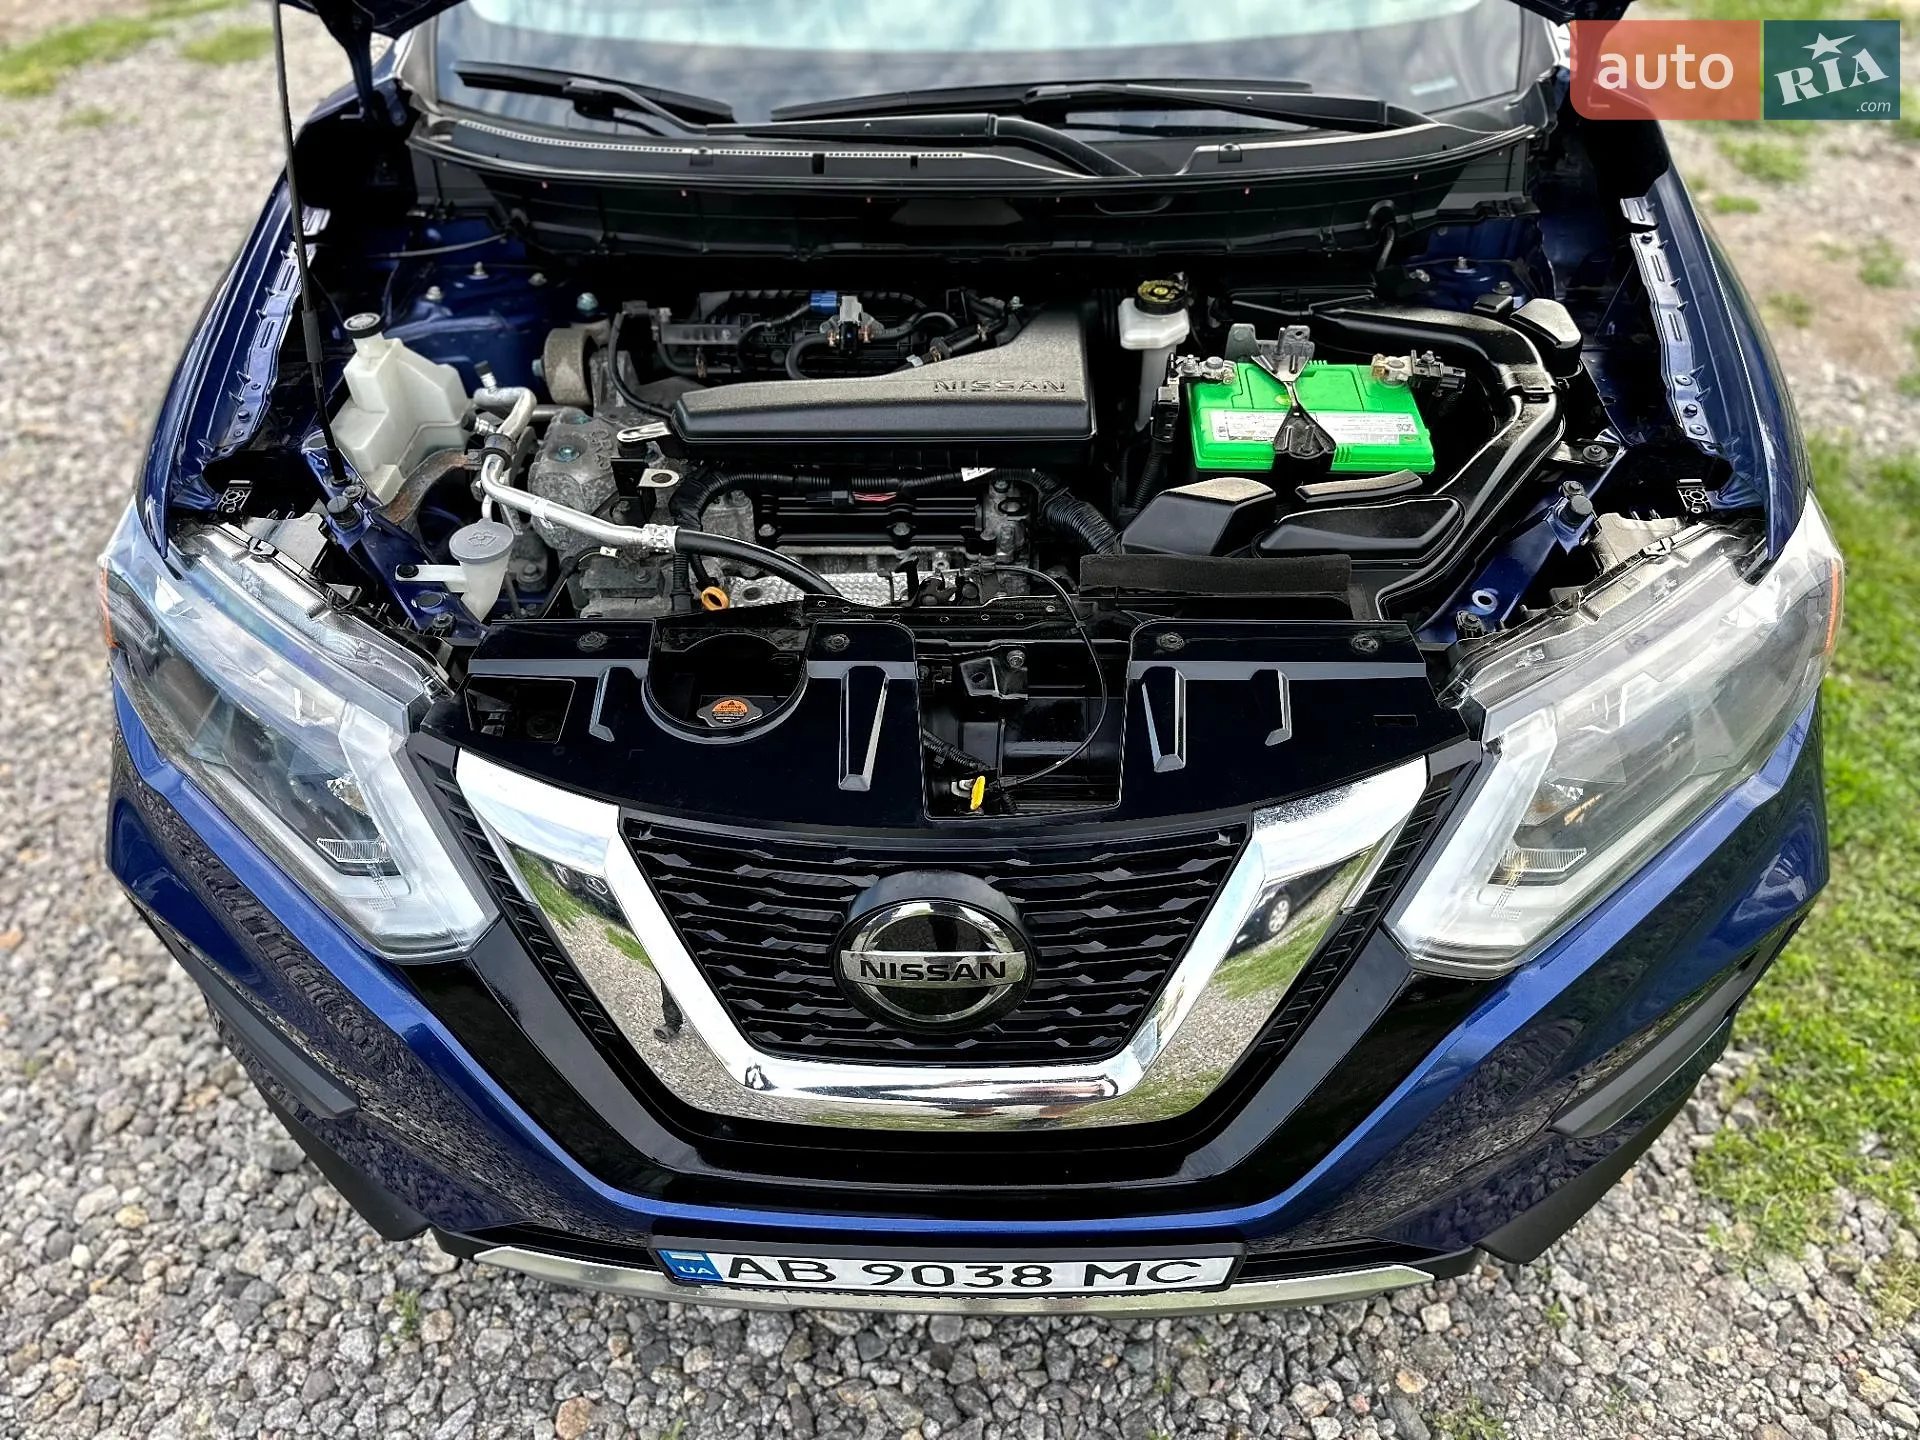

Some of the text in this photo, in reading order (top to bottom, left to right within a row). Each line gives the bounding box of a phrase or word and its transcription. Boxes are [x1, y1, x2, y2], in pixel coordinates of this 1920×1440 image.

[934, 380, 1066, 393] NISSAN
[859, 959, 1006, 982] NISSAN
[678, 1265, 714, 1276] UA
[727, 1257, 1202, 1288] AB 9038 MC
